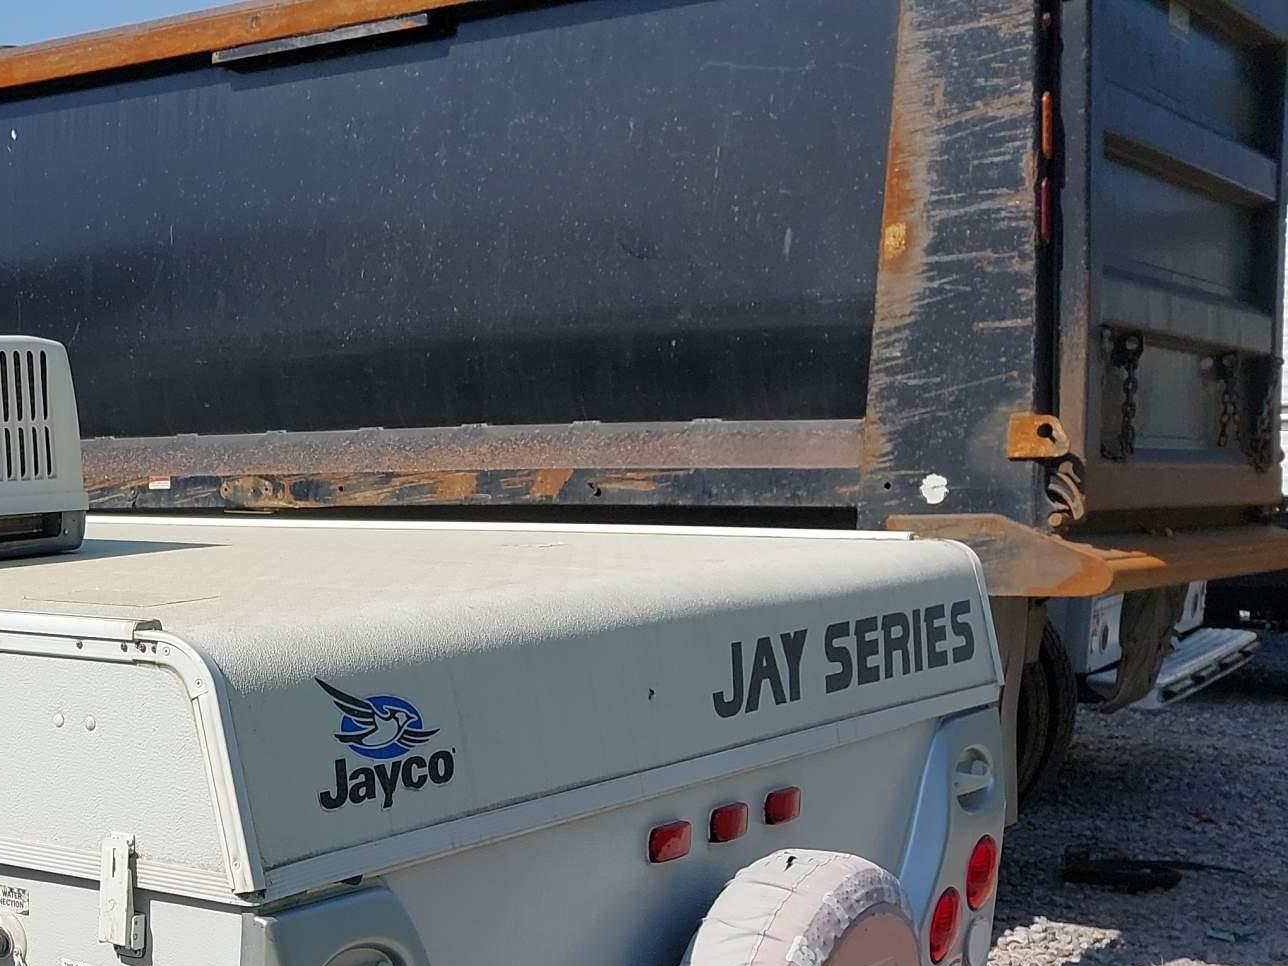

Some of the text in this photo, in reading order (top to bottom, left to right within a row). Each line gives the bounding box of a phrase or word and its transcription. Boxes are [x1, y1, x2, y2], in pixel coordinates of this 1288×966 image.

[712, 600, 975, 718] JAY SERIES
[319, 750, 454, 809] Jayco
